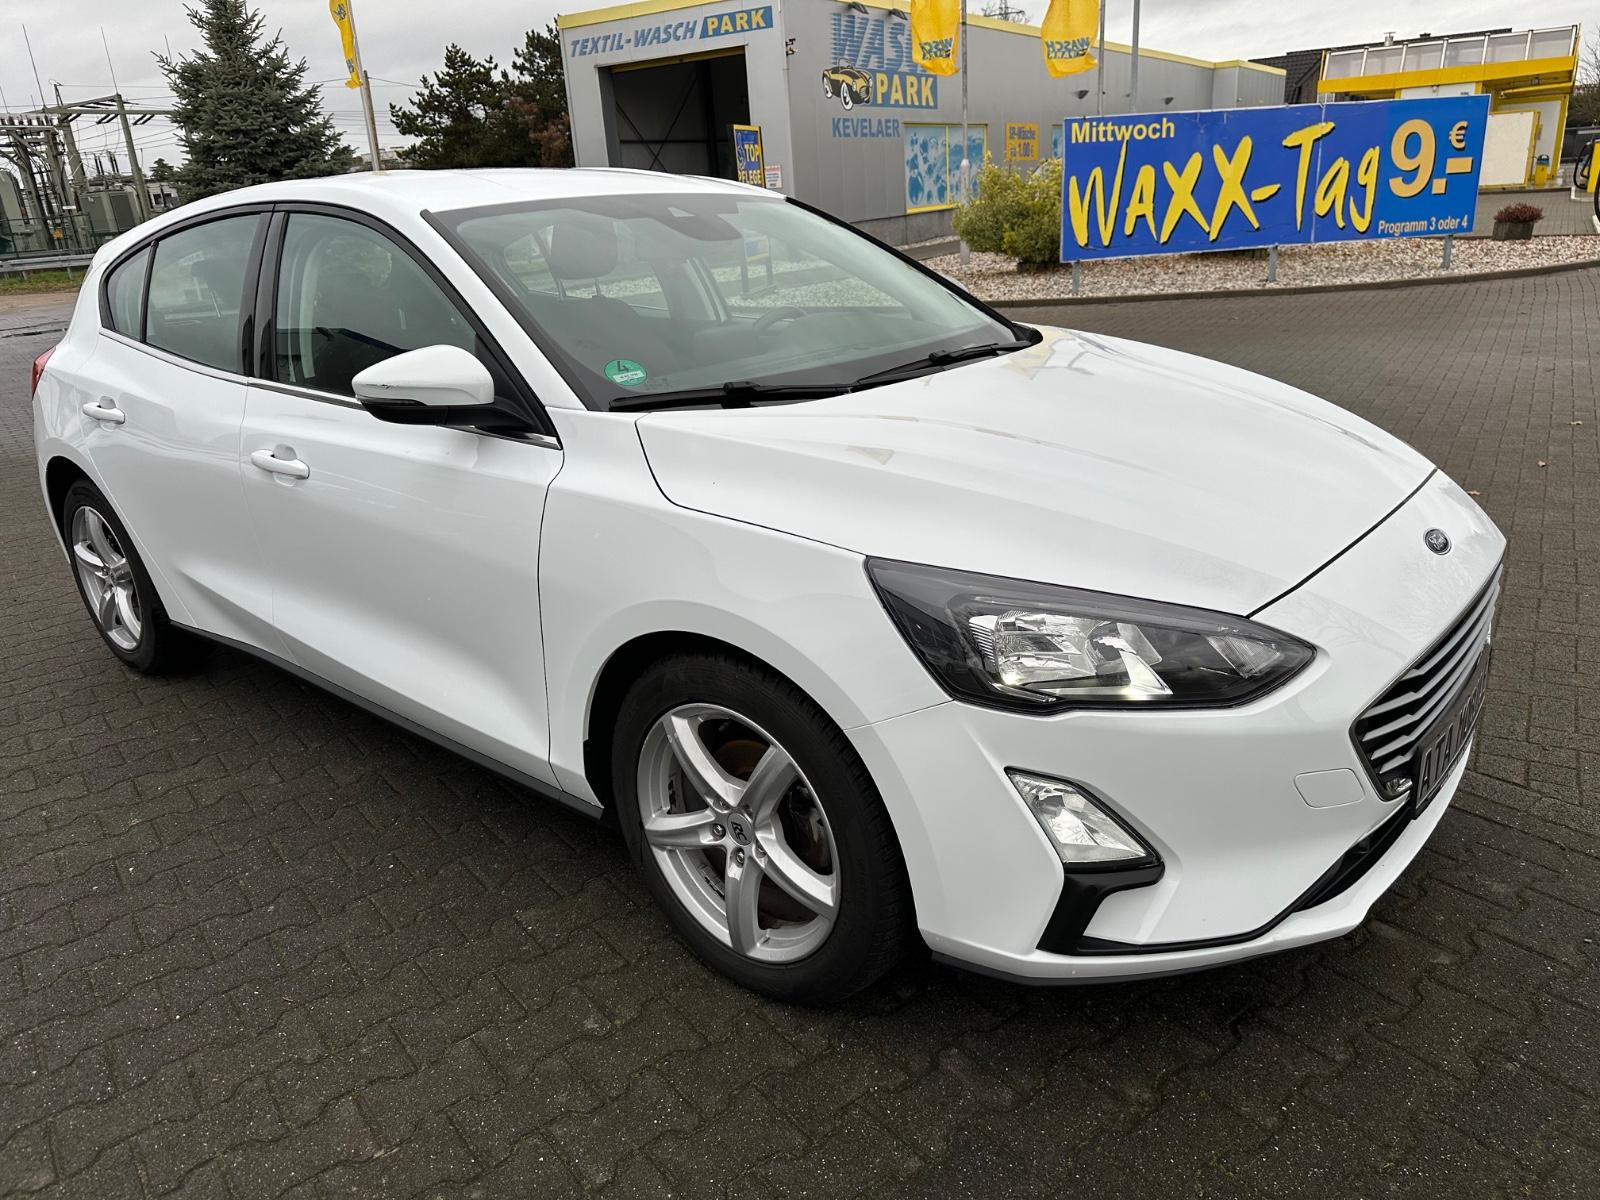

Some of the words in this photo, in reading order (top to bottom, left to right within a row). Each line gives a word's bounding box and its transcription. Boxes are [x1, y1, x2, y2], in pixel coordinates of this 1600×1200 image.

[570, 19, 698, 58] TEXTIL-WASCH
[706, 9, 766, 36] PARK
[875, 72, 935, 107] PARK
[831, 117, 901, 138] KEVELAER
[1071, 117, 1175, 144] Mittwoch
[744, 144, 760, 162] TOP
[1378, 220, 1428, 236] Programm
[1429, 216, 1437, 231] 3
[1438, 216, 1461, 230] oder
[1461, 214, 1469, 229] 4
[616, 360, 630, 373] 4
